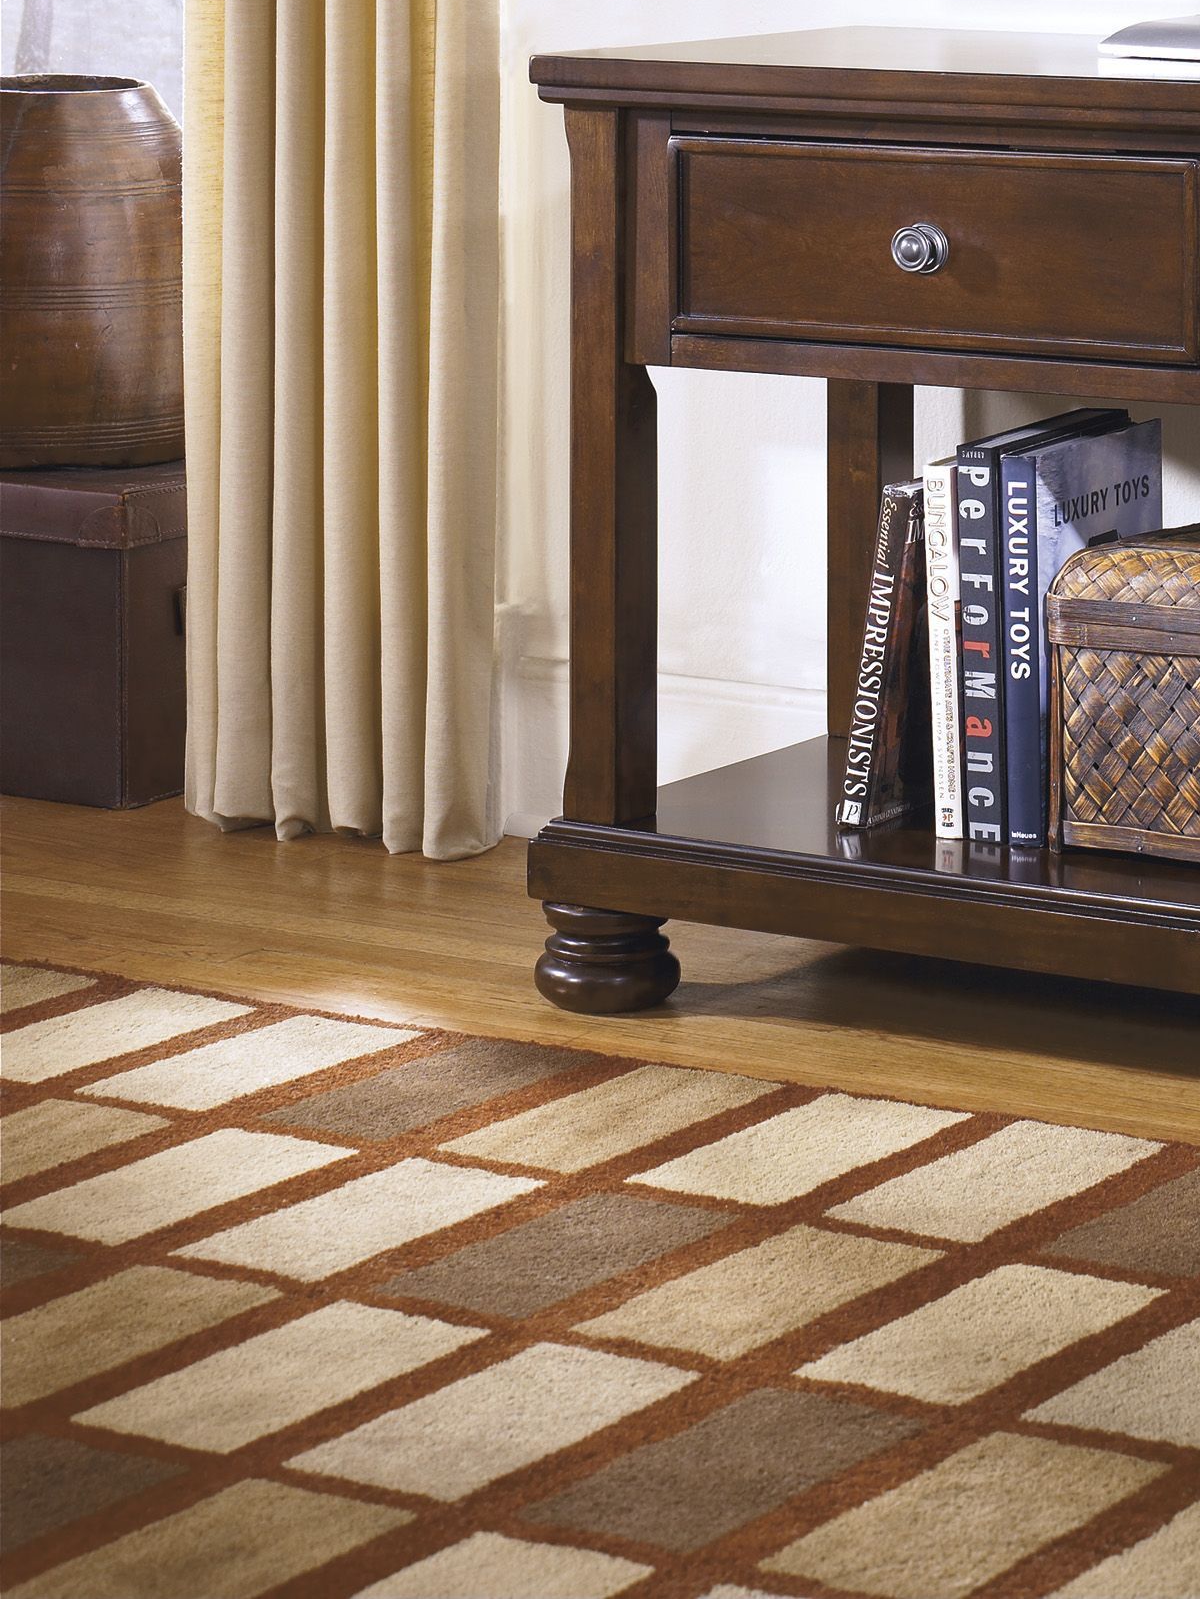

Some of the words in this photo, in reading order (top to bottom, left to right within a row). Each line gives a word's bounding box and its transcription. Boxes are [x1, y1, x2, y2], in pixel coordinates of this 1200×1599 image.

[876, 497, 898, 569] Essential
[1007, 481, 1030, 596] LUXURY
[1054, 486, 1109, 527] LUXURY
[1113, 474, 1150, 506] TOYS
[926, 477, 950, 622] BUNGALOW
[843, 569, 895, 797] IMPRESSIONISTS
[1009, 607, 1031, 680] TOYS
